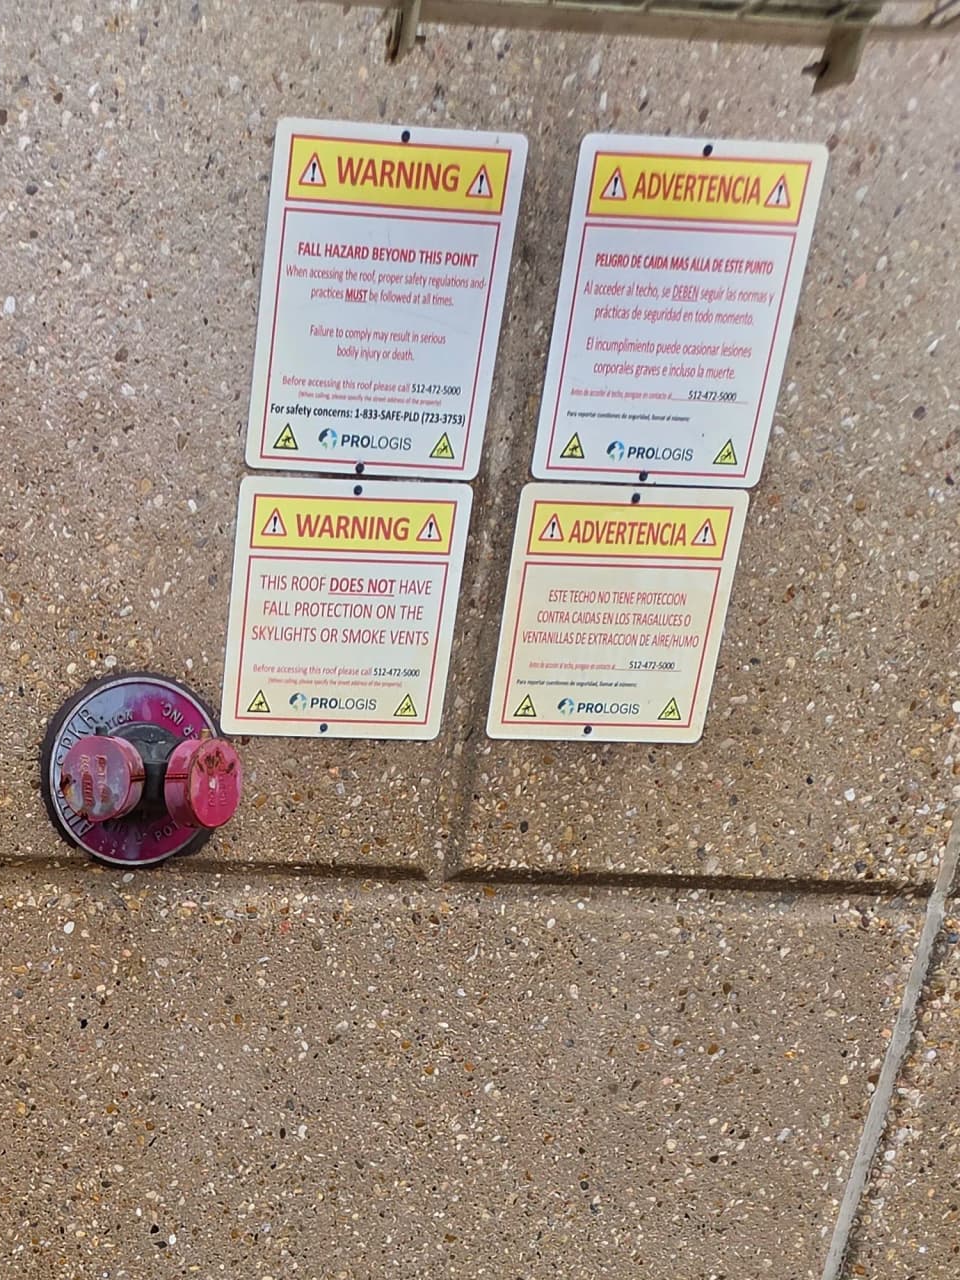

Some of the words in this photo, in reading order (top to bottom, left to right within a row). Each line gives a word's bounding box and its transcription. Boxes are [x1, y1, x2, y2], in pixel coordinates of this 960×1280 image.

[337, 155, 460, 192] WARNING
[631, 171, 760, 204] ADVERTENCIA
[297, 241, 321, 256] FALL
[324, 243, 369, 259] HAZARD
[371, 246, 416, 262] BEYOND
[419, 249, 442, 264] THIS
[444, 251, 478, 267] POINT
[594, 252, 629, 268] PELIGRO
[630, 254, 642, 268] DE
[711, 258, 723, 272] DE
[724, 258, 743, 273] ESTE
[744, 260, 773, 274] PUNTO
[285, 263, 307, 277] When
[308, 267, 343, 282] accessing
[345, 268, 357, 280] the
[377, 273, 403, 285] proper
[404, 271, 427, 287] safety
[427, 274, 468, 288] regulations
[310, 287, 343, 299] practices
[344, 287, 368, 302] MUST
[368, 288, 378, 302] be
[379, 289, 412, 303] followed
[412, 293, 420, 304] at
[421, 292, 431, 304] all
[583, 279, 593, 294] Al
[593, 280, 625, 296] acceder
[625, 281, 635, 296] al
[660, 286, 670, 298] se
[671, 284, 700, 302] DEBEN
[699, 287, 725, 303] seguir
[725, 287, 736, 301] las
[737, 290, 767, 303] normas
[768, 293, 774, 306] y
[593, 303, 630, 320] prácticas
[631, 304, 642, 320] de
[642, 307, 682, 323] seguridad
[682, 311, 693, 322] en
[694, 308, 713, 323] todo
[309, 324, 334, 337] Failure
[335, 327, 343, 338] to
[344, 327, 371, 341] comply
[372, 330, 389, 343] may
[389, 330, 410, 342] result
[411, 332, 419, 342] in
[419, 332, 445, 344] serious
[336, 344, 359, 359] bodily
[360, 347, 381, 361] injury
[381, 350, 391, 359] or
[585, 335, 594, 350] El
[594, 336, 655, 354] incumplimiento
[655, 340, 681, 356] puede
[682, 342, 720, 356] ocasionar
[720, 342, 752, 358] lesiones
[593, 360, 634, 376] corporales
[634, 364, 660, 378] graves
[661, 365, 667, 376] e
[668, 363, 696, 377] incluso
[696, 364, 704, 378] la
[282, 375, 306, 385] Before
[307, 378, 340, 390] accessing
[342, 379, 355, 389] this
[356, 380, 372, 390] roof
[373, 381, 396, 392] please
[397, 383, 410, 392] call
[411, 383, 461, 396] 512-472-5000
[687, 390, 736, 402] 512-472-5000
[270, 402, 284, 413] For
[285, 403, 311, 417] safety
[312, 407, 352, 418] concerns:
[354, 408, 419, 422] 1-833-SAFE-PLD
[420, 411, 465, 427] (723-3753)
[340, 434, 411, 450] PROLOGIS
[626, 446, 693, 461] PROLOGIS
[296, 513, 410, 541] WARNING
[567, 519, 686, 546] ADVERTENCIA
[260, 574, 287, 590] THIS
[290, 575, 326, 591] ROOF
[327, 577, 365, 596] DOES
[364, 578, 396, 597] NOT
[398, 579, 432, 595] HAVE
[548, 589, 568, 602] ESTE
[569, 589, 596, 603] TECHO
[597, 591, 610, 603] NO
[612, 591, 635, 604] TIENE
[263, 600, 290, 616] FALL
[294, 601, 372, 618] PROTECTION
[375, 604, 396, 619] ON
[399, 604, 423, 620] THE
[536, 610, 569, 623] CONTRA
[601, 612, 614, 624] EN
[614, 612, 631, 625] LOS
[632, 612, 683, 626] TRAGALUCES
[683, 613, 691, 627] O
[251, 625, 316, 642] SKYLIGHTS
[319, 627, 338, 642] OR
[340, 628, 386, 644] SMOKE
[390, 629, 429, 645] VENTS
[522, 630, 574, 644] VENTANILLAS
[574, 632, 586, 645] DE
[638, 633, 650, 646] DE
[252, 663, 274, 672] Before
[276, 666, 307, 675] accessing
[308, 666, 321, 674] this
[322, 666, 337, 674] roof
[337, 667, 359, 676] please
[360, 667, 372, 675] call
[372, 667, 420, 677] 512-472-5000
[629, 660, 675, 670] 512-472-5000
[310, 697, 376, 710] PROLOGIS
[576, 702, 639, 714] PROLOGIS
